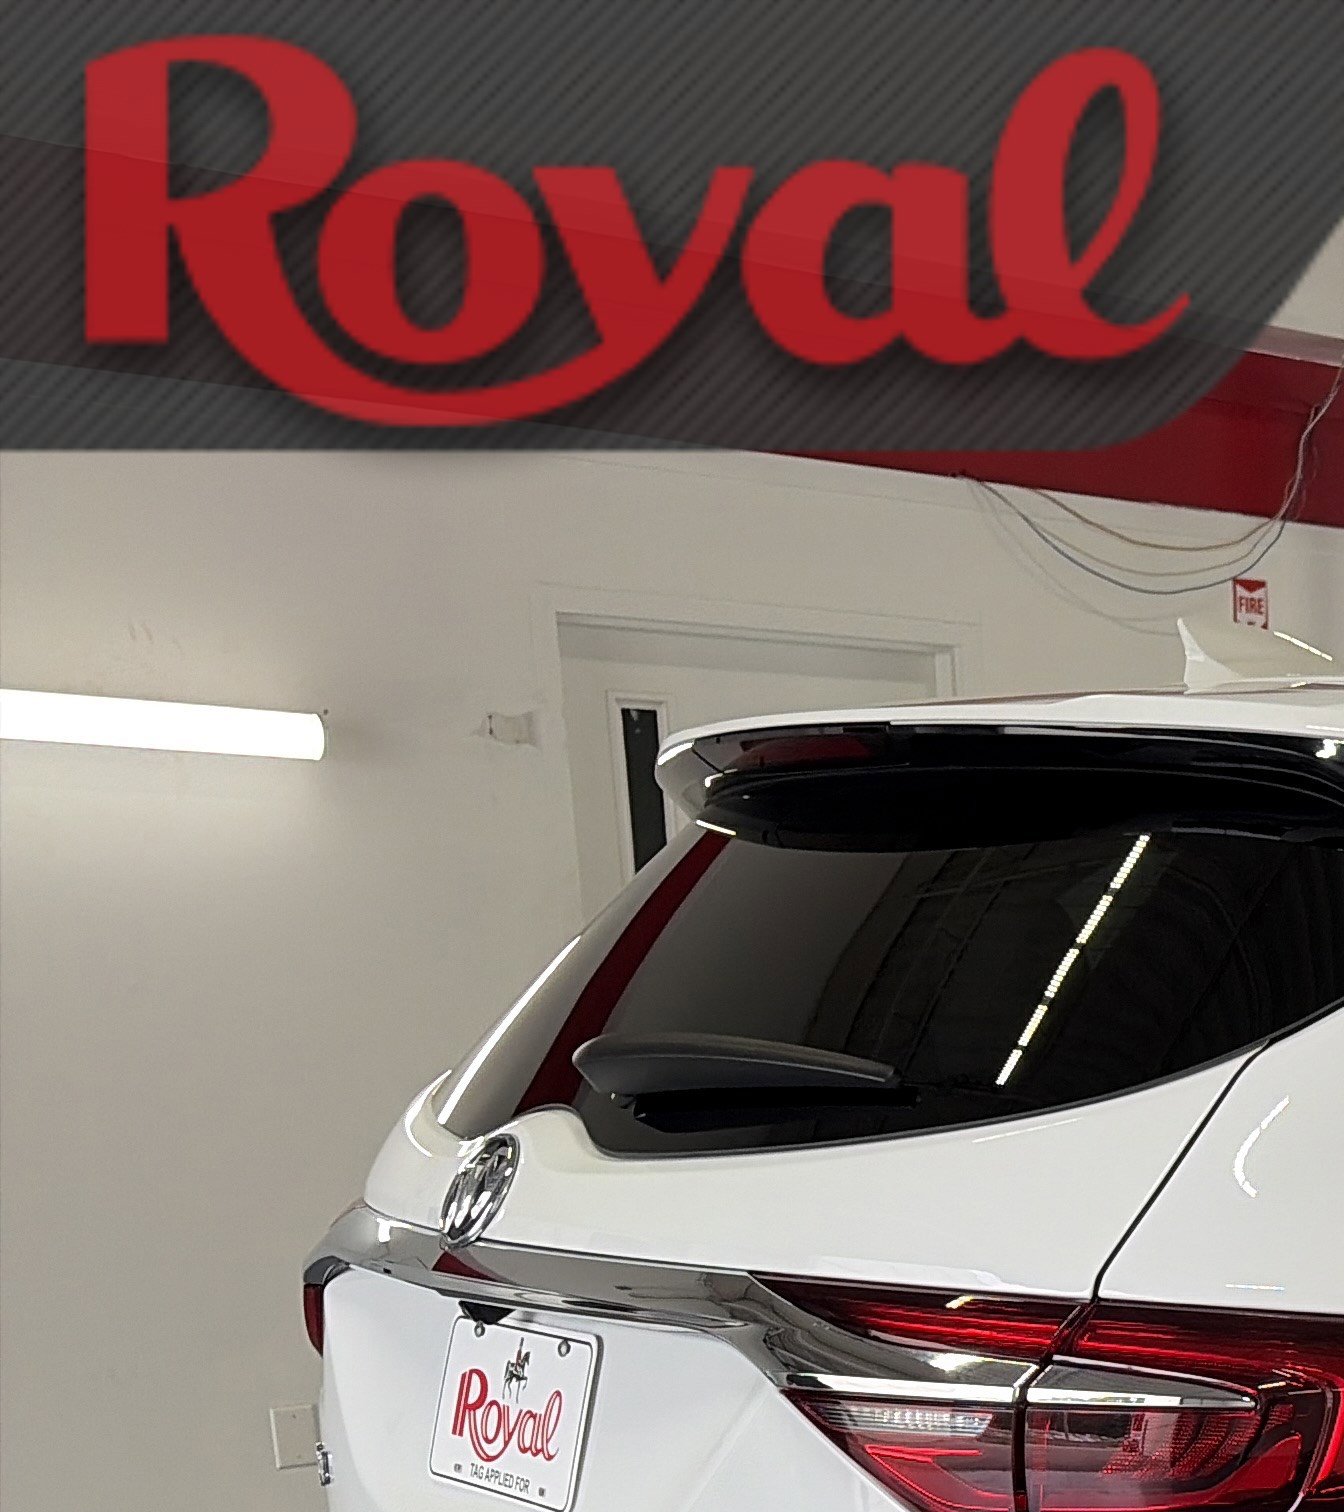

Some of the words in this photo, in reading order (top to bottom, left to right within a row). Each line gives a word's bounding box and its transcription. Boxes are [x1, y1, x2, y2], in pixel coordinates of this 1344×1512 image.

[1238, 595, 1265, 616] FIRE
[451, 1368, 562, 1463] Royal
[470, 1463, 484, 1481] TAG
[484, 1468, 514, 1489] APPLIED
[514, 1476, 531, 1494] FOR
